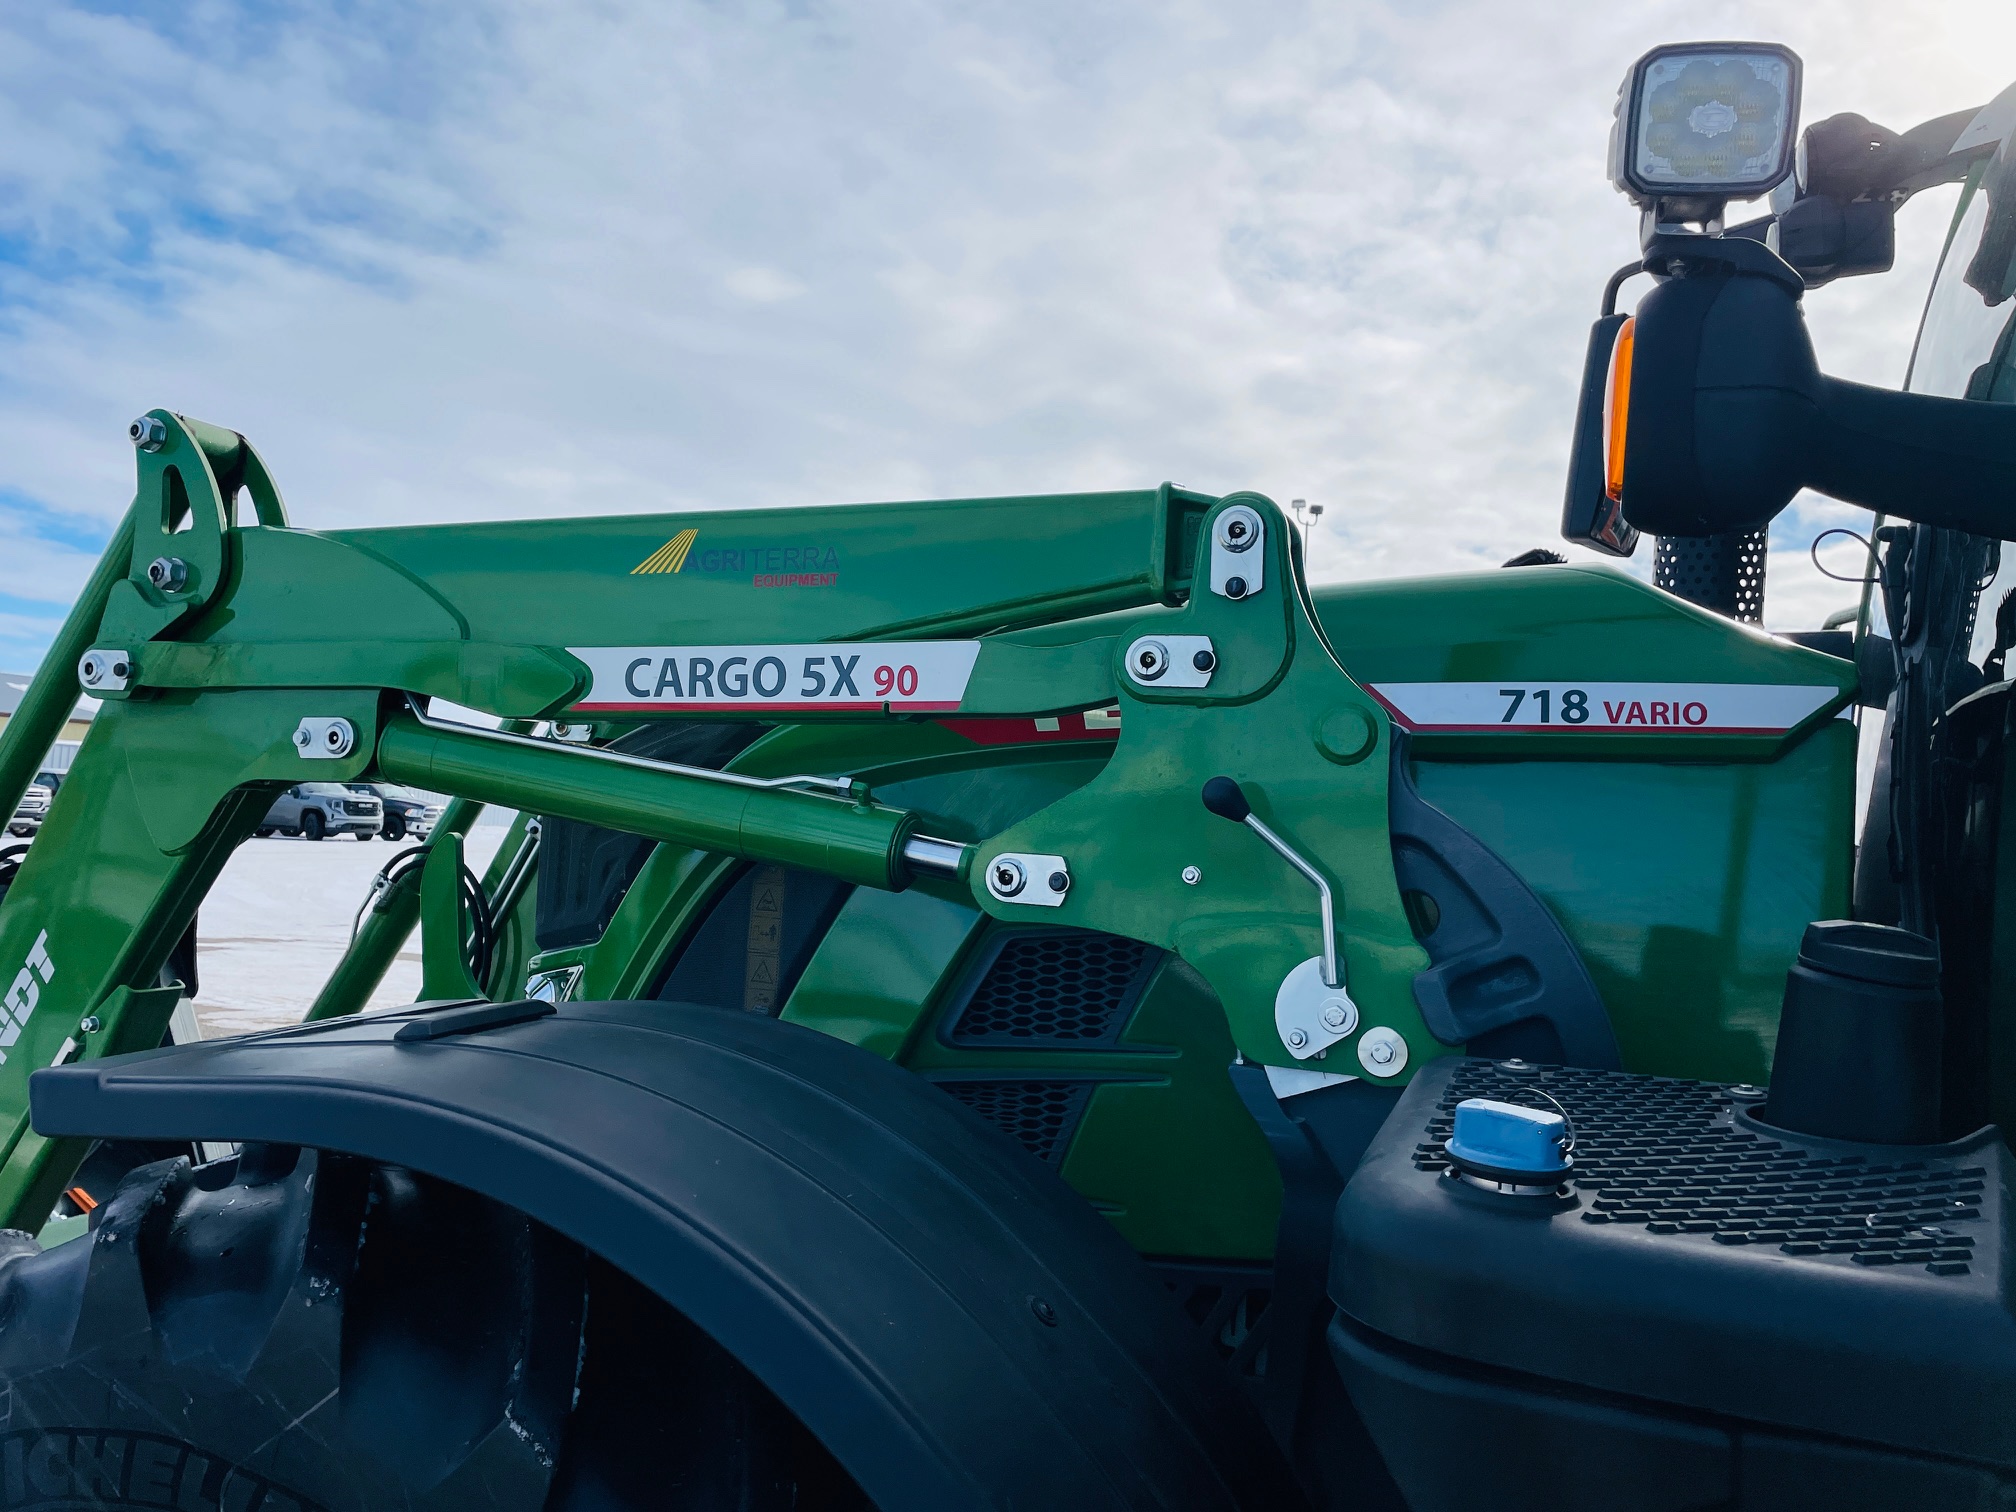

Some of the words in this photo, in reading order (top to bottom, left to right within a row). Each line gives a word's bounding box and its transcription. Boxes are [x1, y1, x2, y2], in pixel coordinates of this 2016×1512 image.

[681, 546, 840, 572] AGRITERRA
[753, 573, 839, 588] EQUIPMENT
[624, 656, 787, 699] CARGO
[801, 655, 861, 698] 5X
[874, 665, 918, 697] 90
[1499, 688, 1590, 725] 718
[1604, 701, 1708, 726] VARIO
